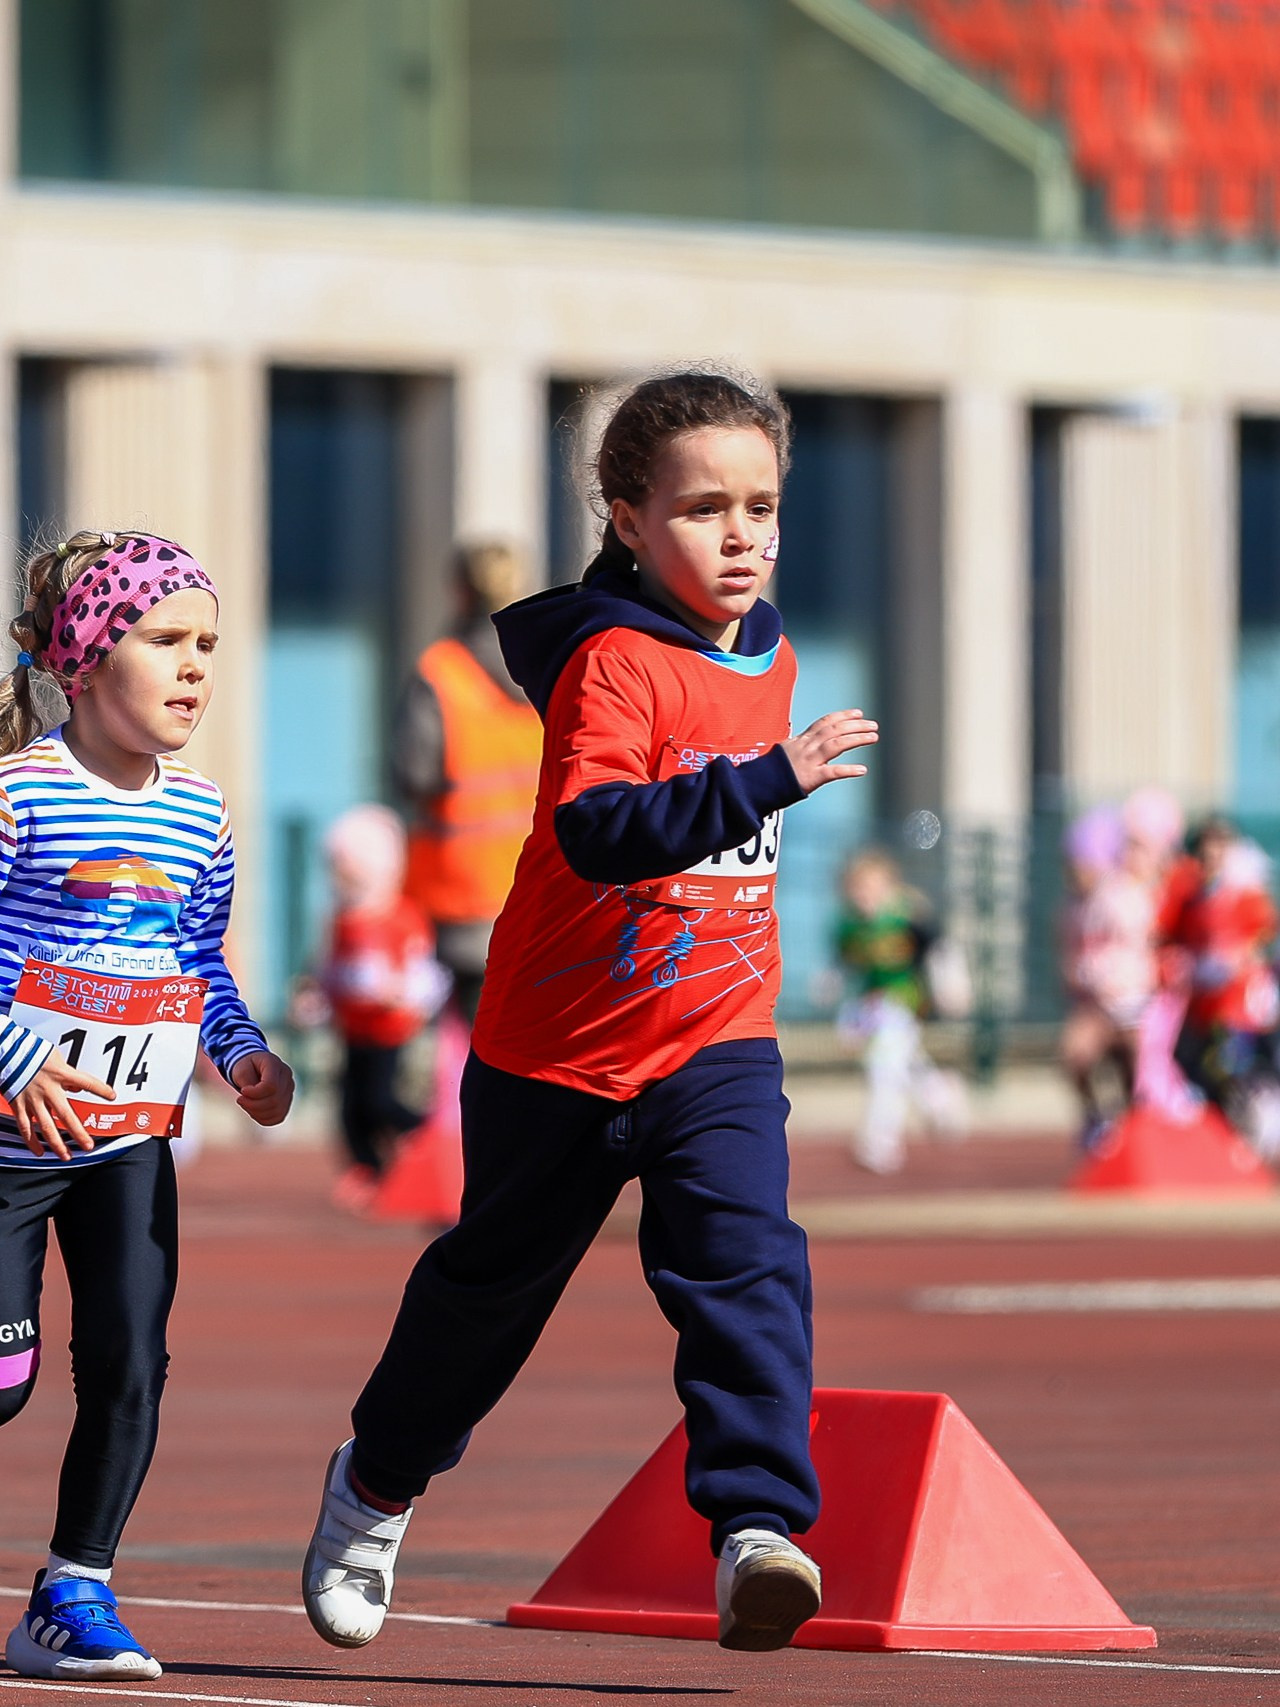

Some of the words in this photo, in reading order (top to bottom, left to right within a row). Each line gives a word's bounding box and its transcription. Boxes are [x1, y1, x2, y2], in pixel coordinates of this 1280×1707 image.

[111, 952, 156, 971] Grand
[37, 967, 133, 1000] ДЕТСКИЙ
[133, 988, 159, 998] 2026
[48, 987, 116, 1014] ЗАБЕГ
[156, 998, 189, 1019] 4-5
[59, 1028, 154, 1092] 114
